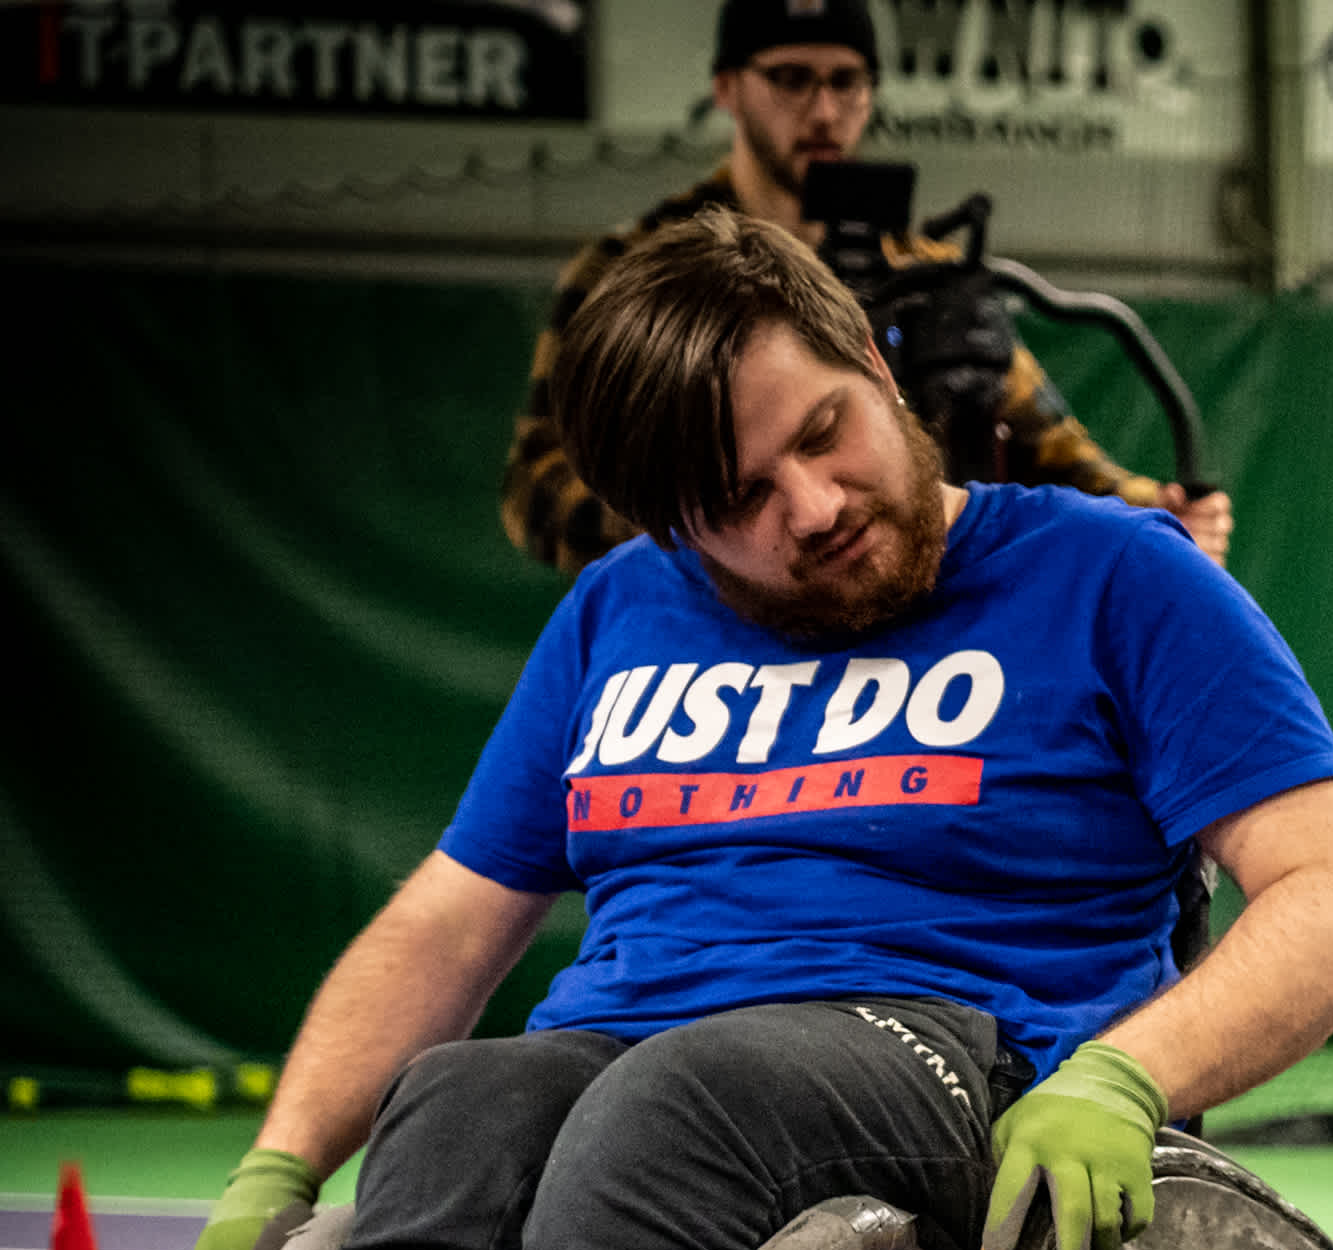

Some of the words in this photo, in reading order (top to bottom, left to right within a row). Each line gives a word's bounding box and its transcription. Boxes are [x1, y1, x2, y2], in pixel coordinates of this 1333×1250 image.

[566, 659, 822, 775] JUST
[811, 648, 1006, 755] DO
[571, 765, 930, 822] NOTHING
